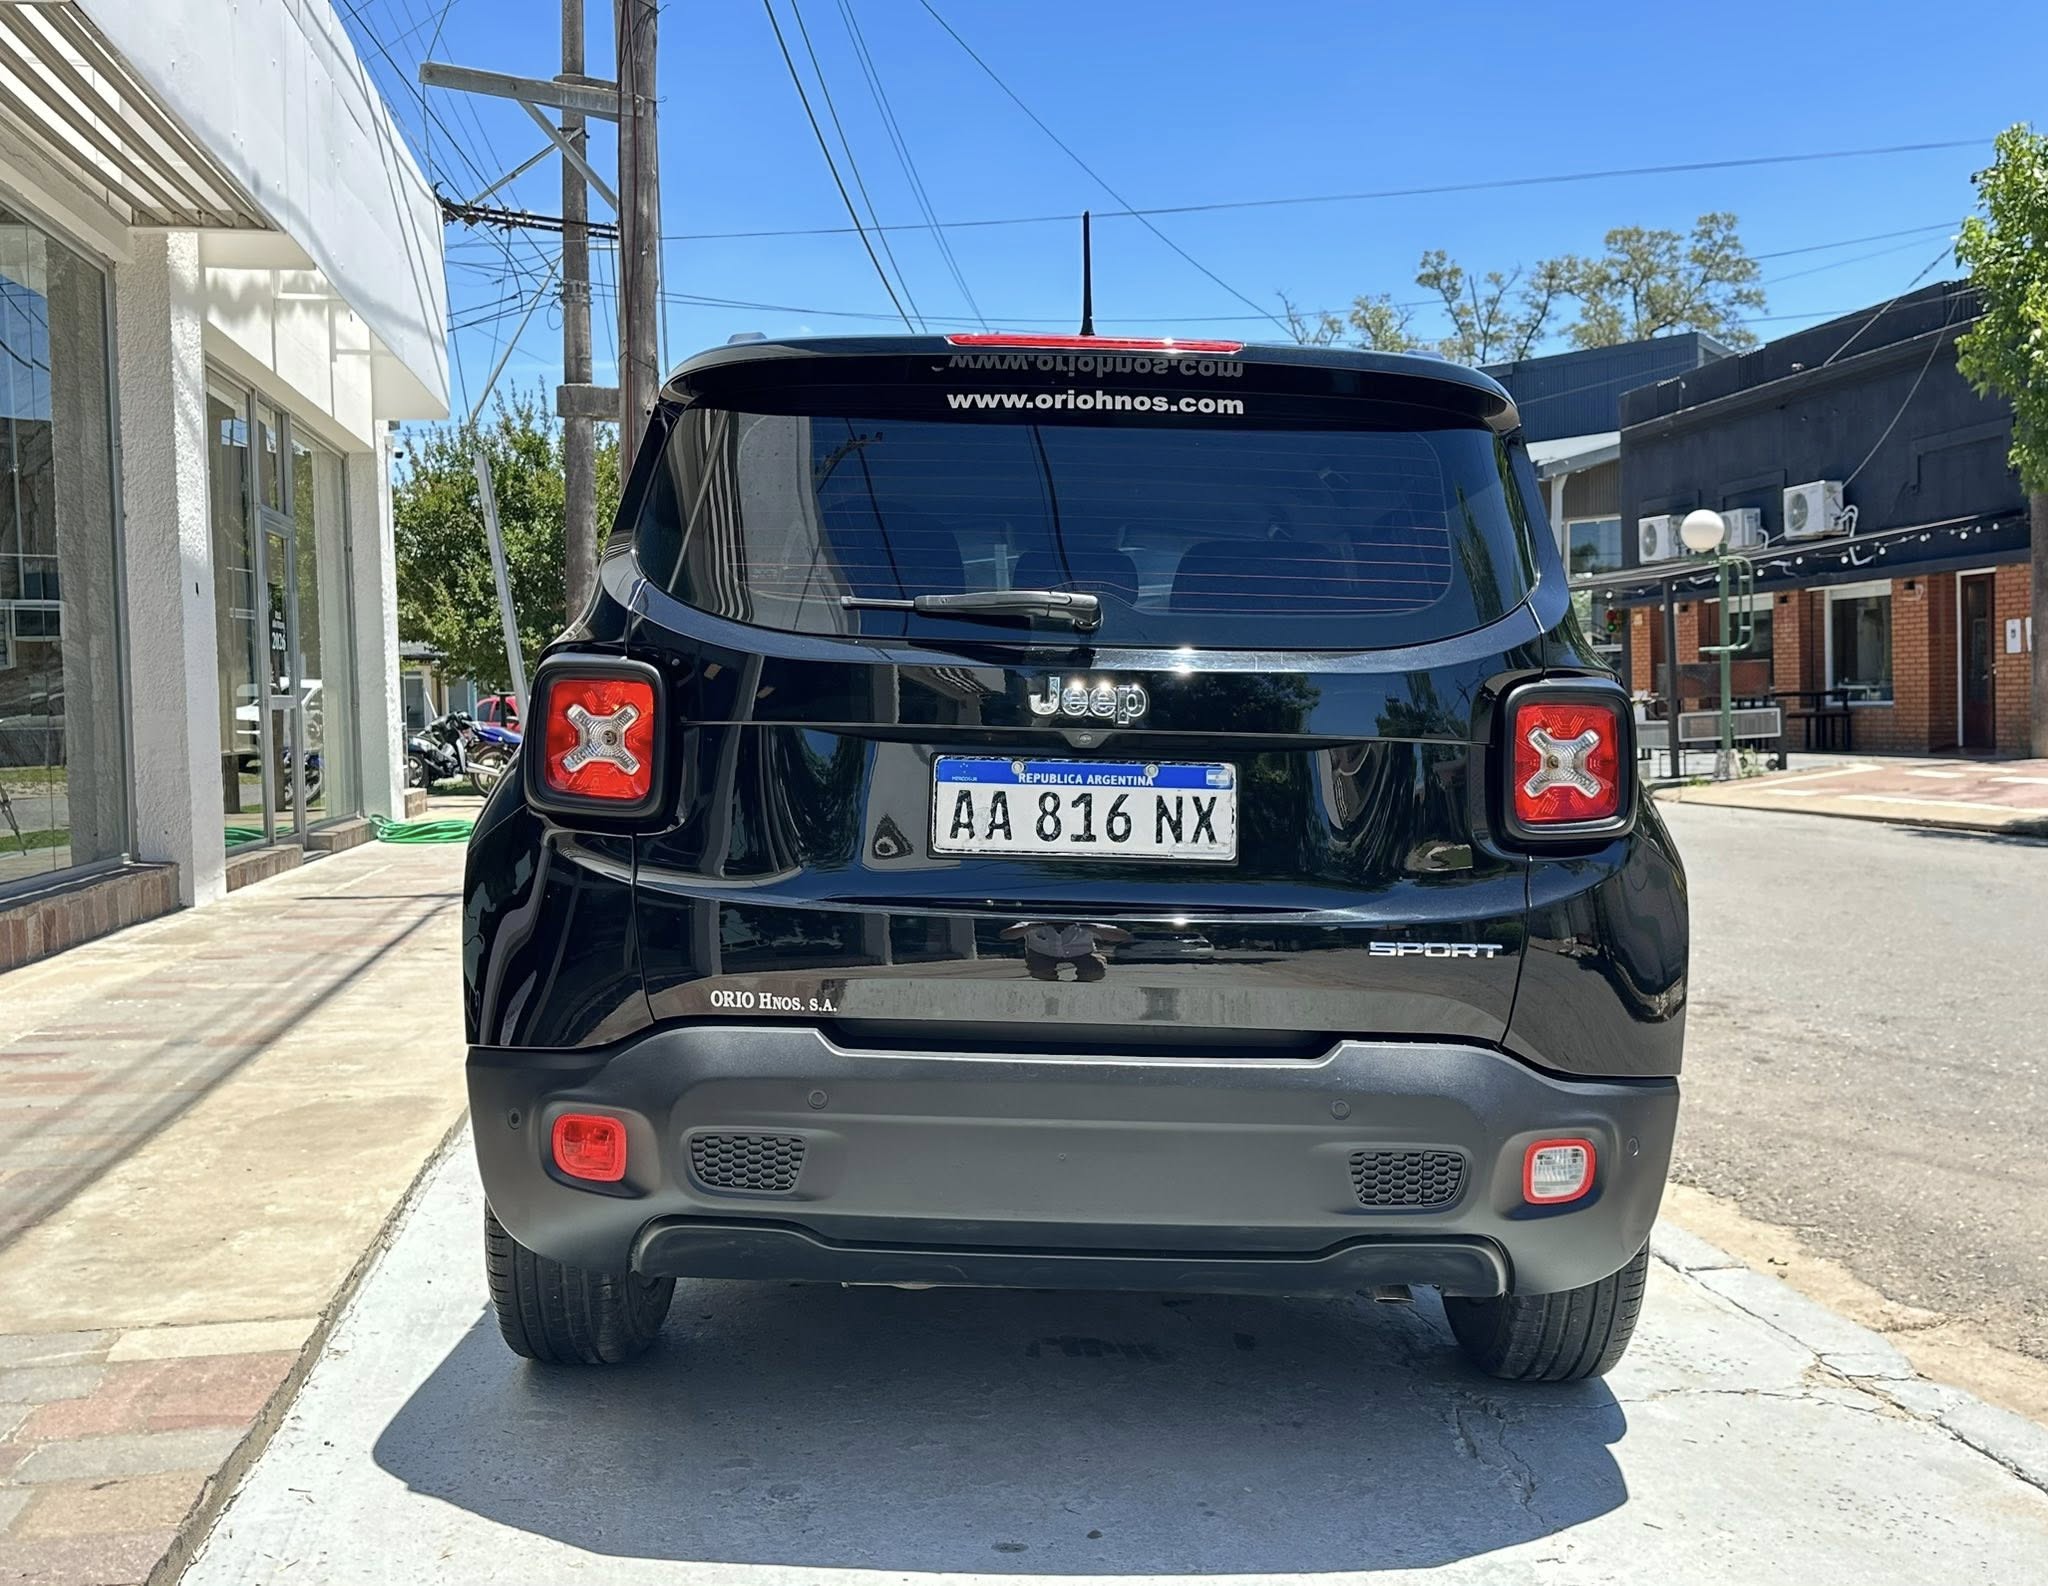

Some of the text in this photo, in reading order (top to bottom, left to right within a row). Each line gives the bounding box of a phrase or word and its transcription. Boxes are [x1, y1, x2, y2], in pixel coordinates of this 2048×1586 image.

[947, 390, 1244, 415] www.oriohnos.com
[1029, 676, 1148, 725] Jeep
[1018, 773, 1154, 786] REPUBLICA ARGENTINA
[949, 789, 1218, 845] AA 816 NX
[1368, 941, 1504, 959] SPORT
[710, 990, 755, 1009] ORIO
